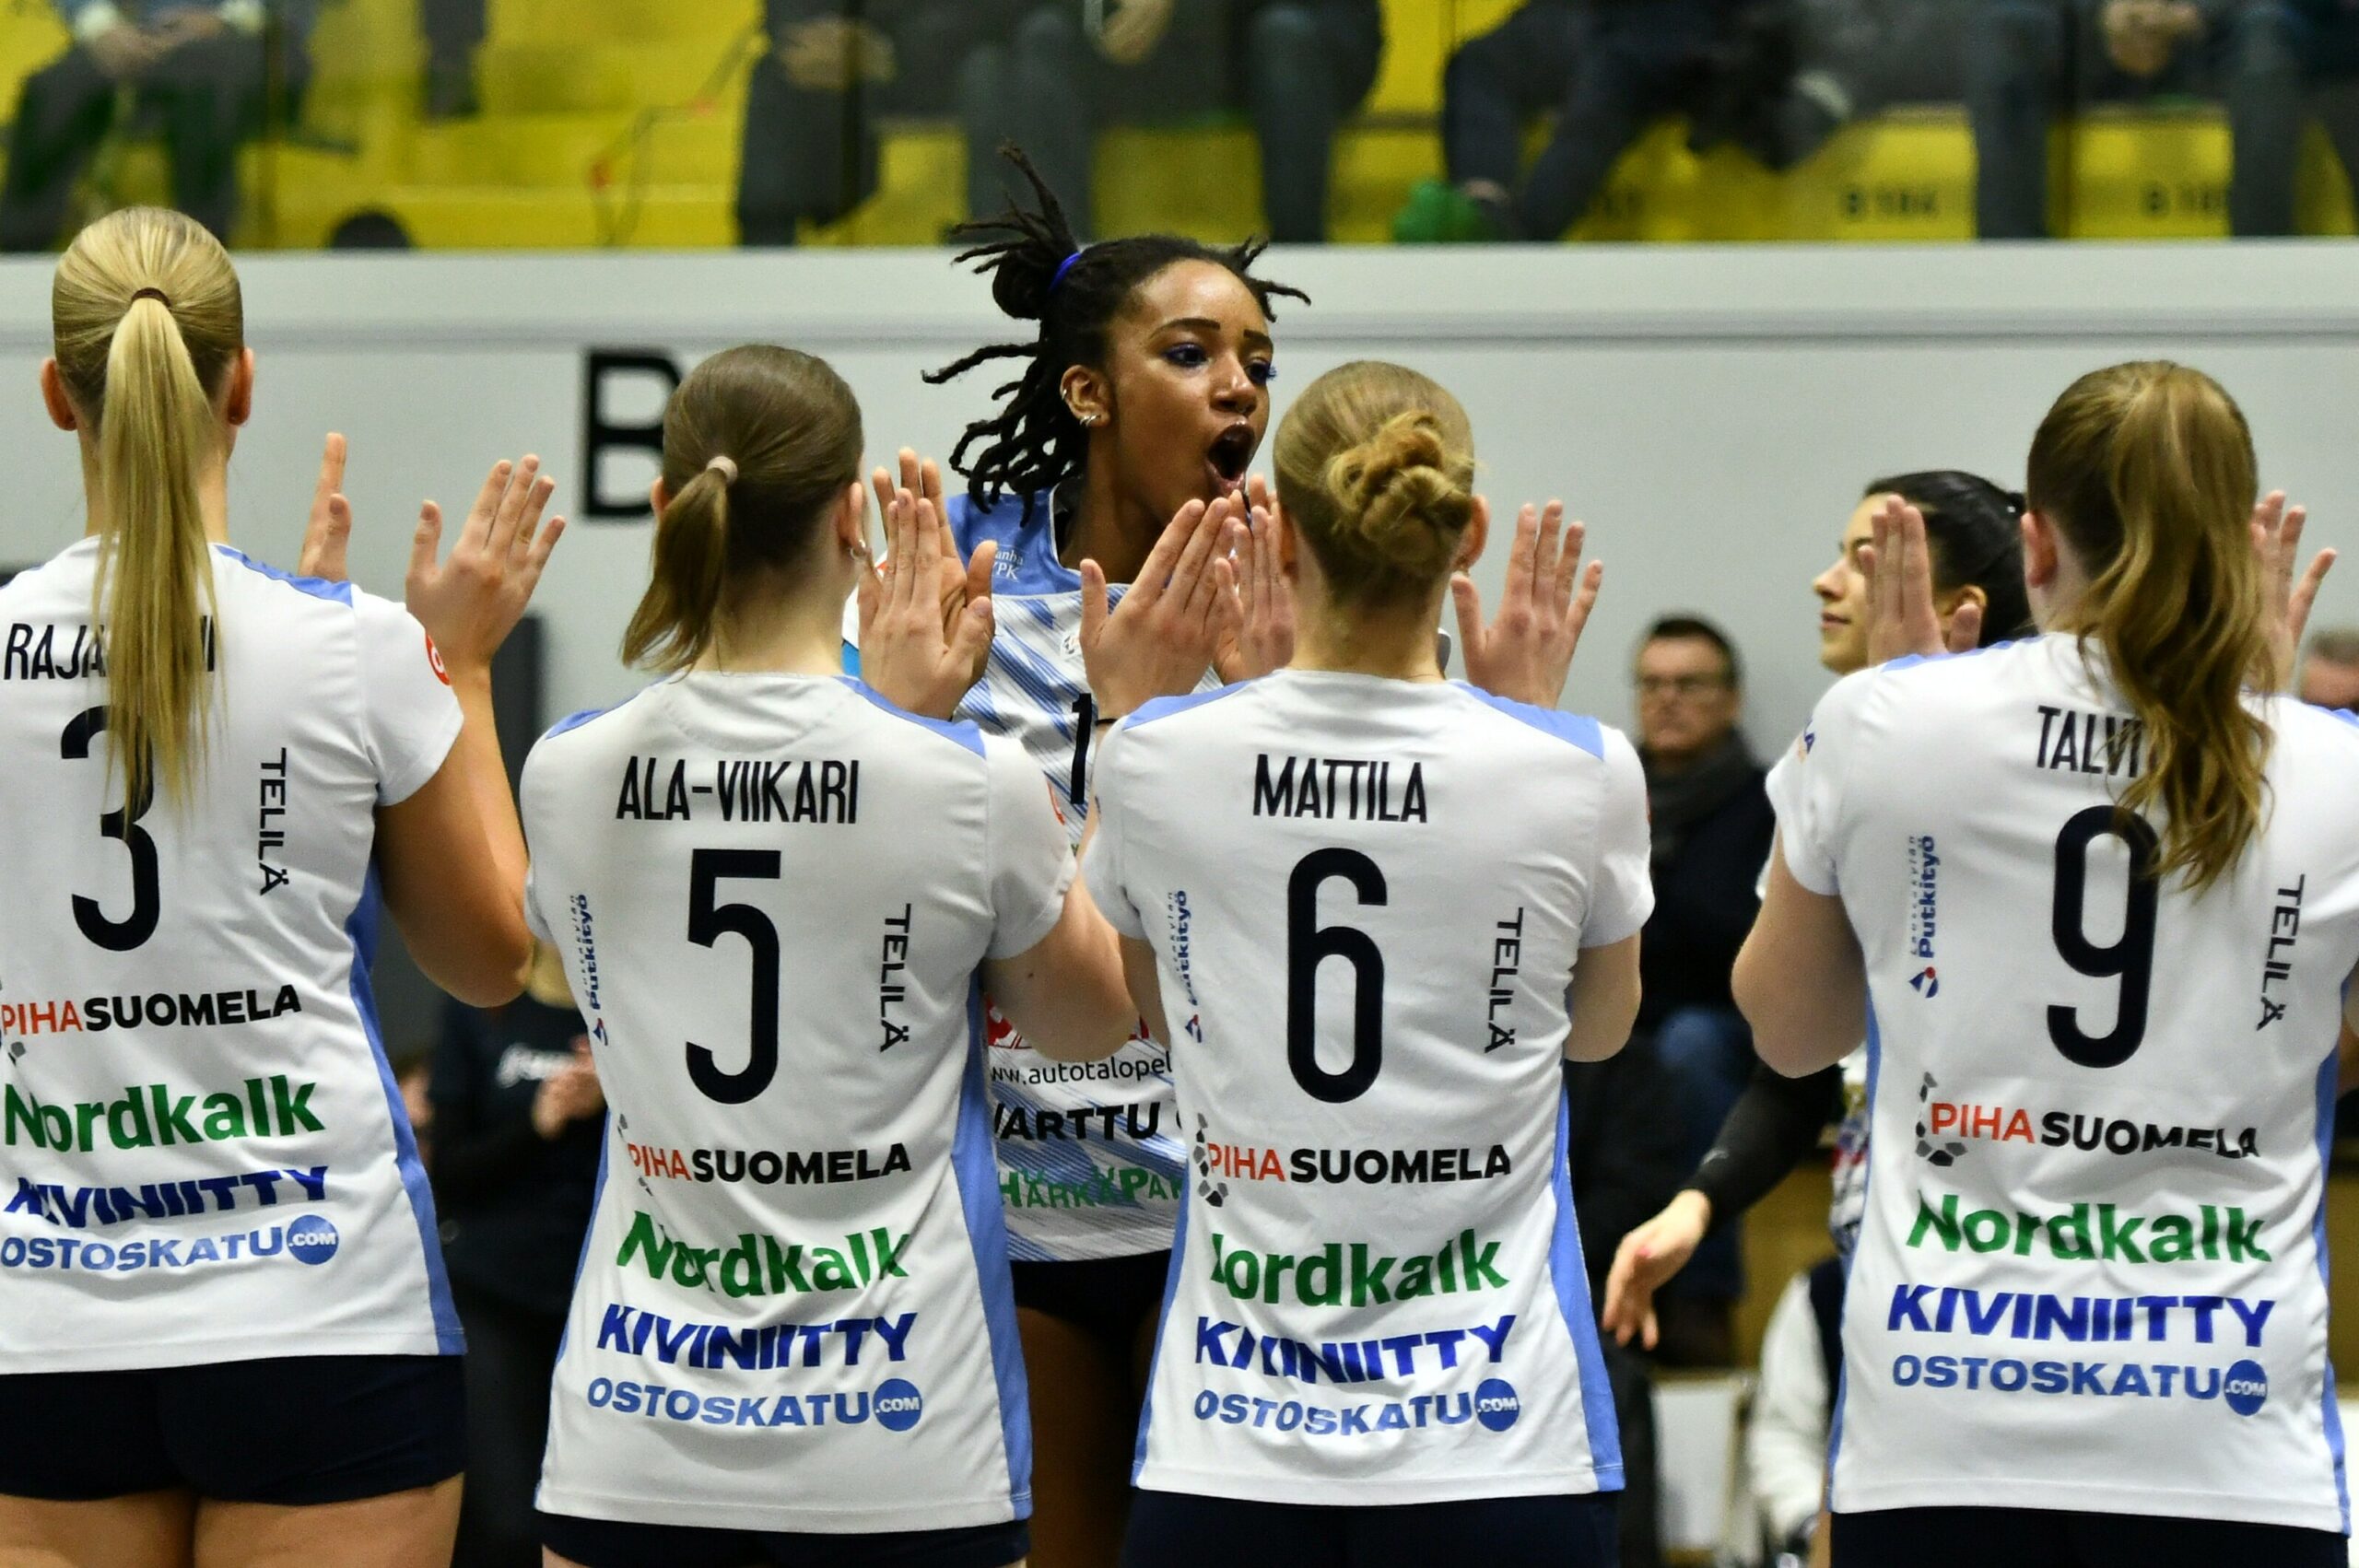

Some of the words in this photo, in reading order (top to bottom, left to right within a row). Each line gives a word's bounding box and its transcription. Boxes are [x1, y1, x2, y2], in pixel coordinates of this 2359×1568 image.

[581, 347, 683, 519] B
[995, 549, 1024, 566] anha
[4, 614, 215, 680] RAJAI
[616, 755, 860, 824] ALA-VIIKARI
[1070, 693, 1093, 805] 1
[1253, 754, 1427, 824] MATTILA
[61, 705, 159, 952] 3
[260, 747, 289, 896] TELILÄ
[1918, 835, 1941, 959] Putkityö
[2048, 804, 2160, 1069] 9
[2256, 874, 2306, 1032] TELILÄ
[686, 848, 781, 1105] 5
[879, 903, 911, 1053] TELILÄ
[1287, 848, 1388, 1104] 6
[1485, 907, 1524, 1054] TELILÄ
[5, 1074, 325, 1153] Nordkalk
[992, 1050, 1173, 1085] ww.autotalopel
[616, 1210, 910, 1298] Nordkalk
[1907, 1190, 2272, 1264] Nordkalk
[598, 1303, 919, 1371] KIVINIITTY
[1887, 1284, 2276, 1348] KIVINIITTY
